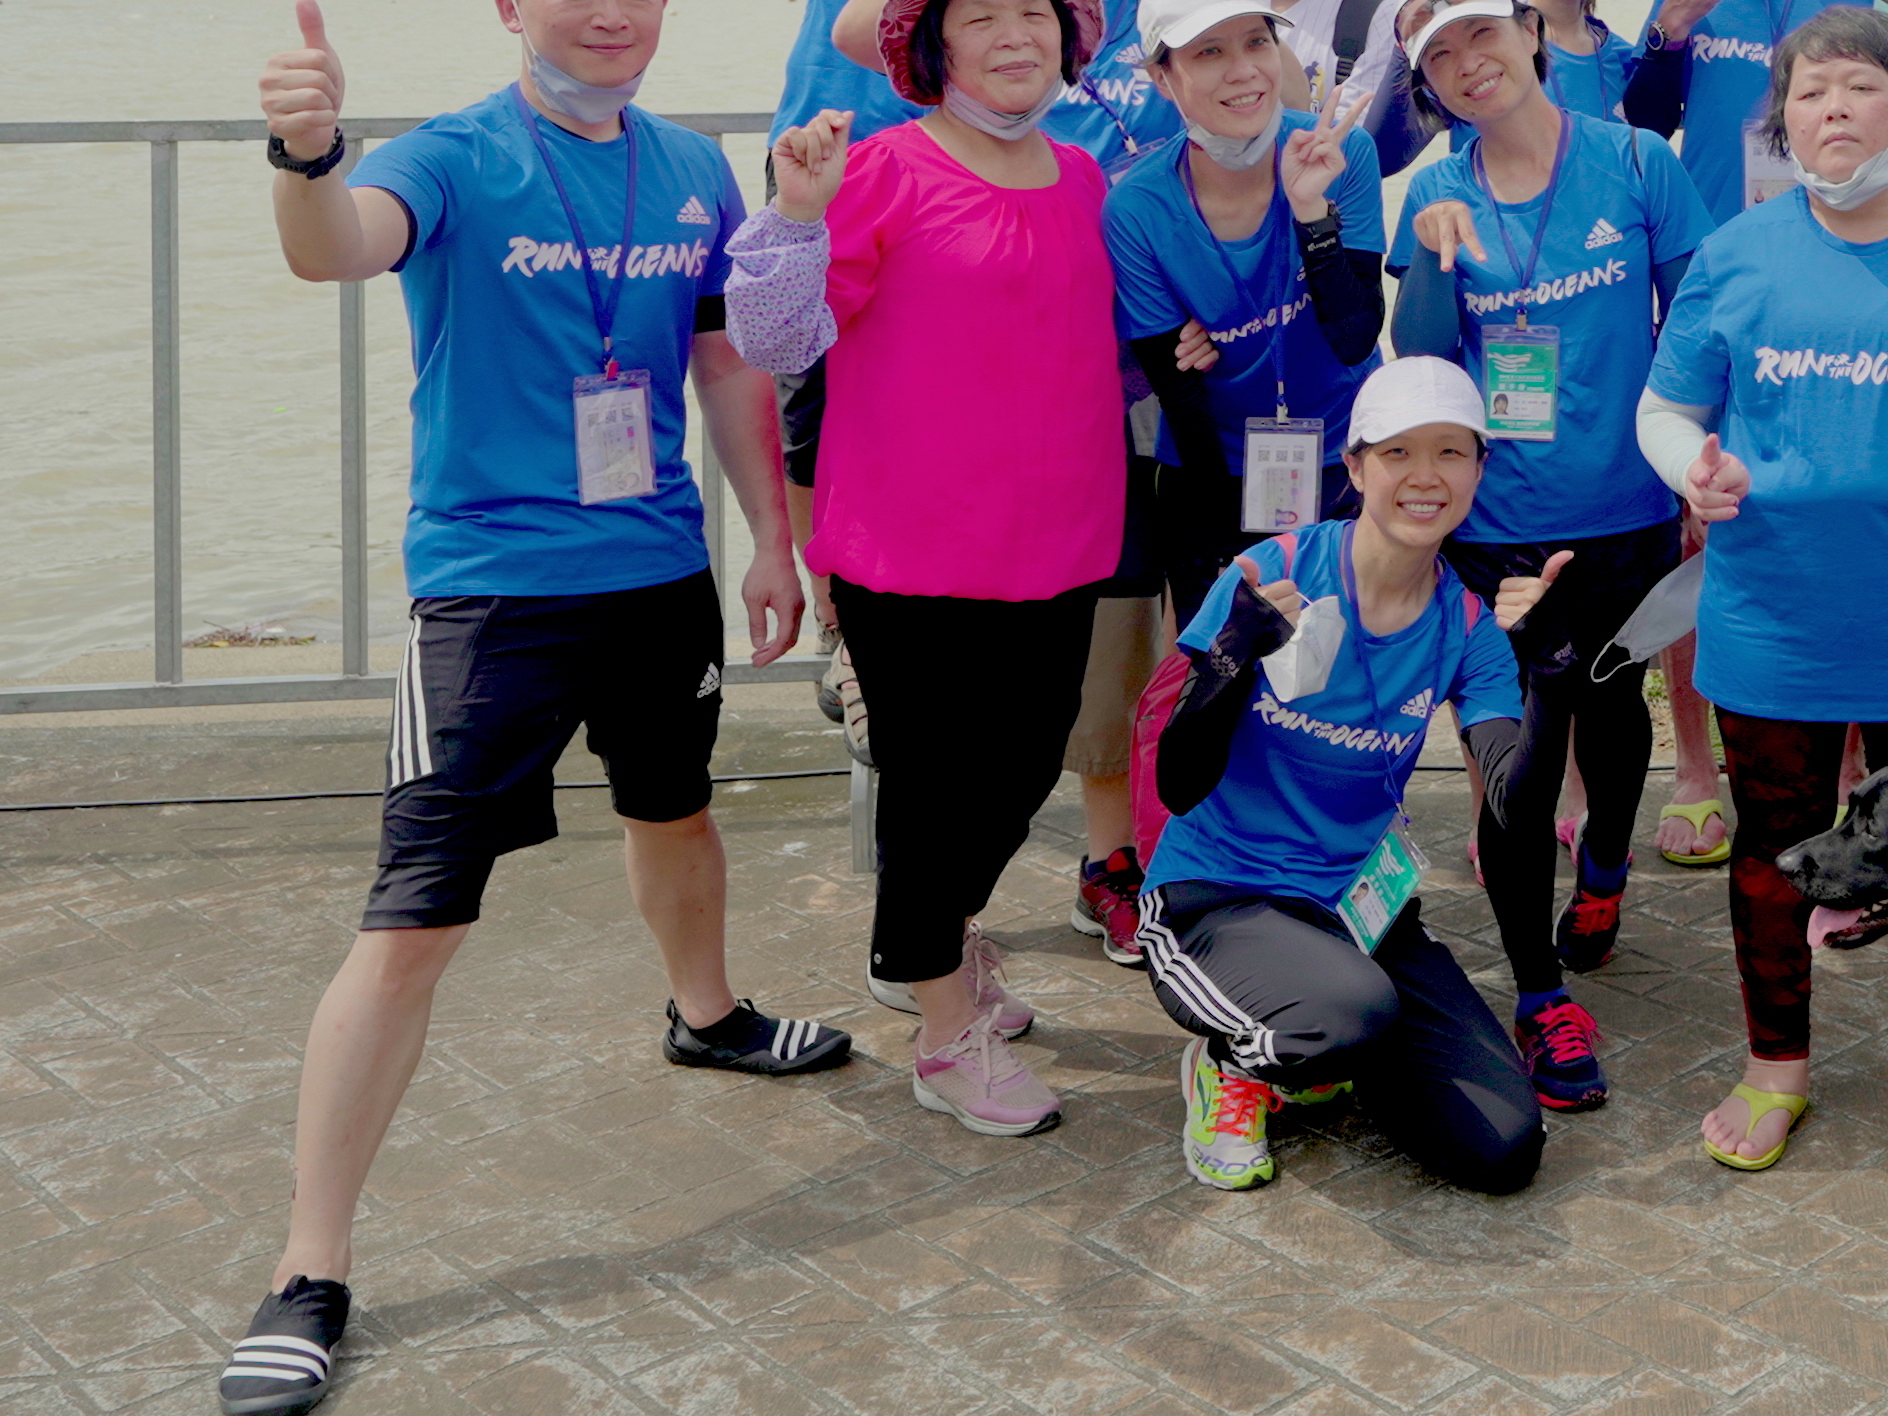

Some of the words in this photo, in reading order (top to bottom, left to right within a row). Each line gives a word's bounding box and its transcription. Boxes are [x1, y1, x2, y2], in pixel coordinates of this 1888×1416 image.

[1692, 33, 1747, 63] RUN
[501, 235, 583, 278] RUN
[1584, 232, 1623, 250] adidas
[1464, 290, 1515, 316] RUN
[1535, 258, 1628, 305] OCEANS
[1209, 322, 1250, 343] UN
[1754, 346, 1827, 385] RUN
[1252, 691, 1315, 735] RUN
[1329, 724, 1417, 755] OCEAN
[1400, 703, 1436, 719] adid
